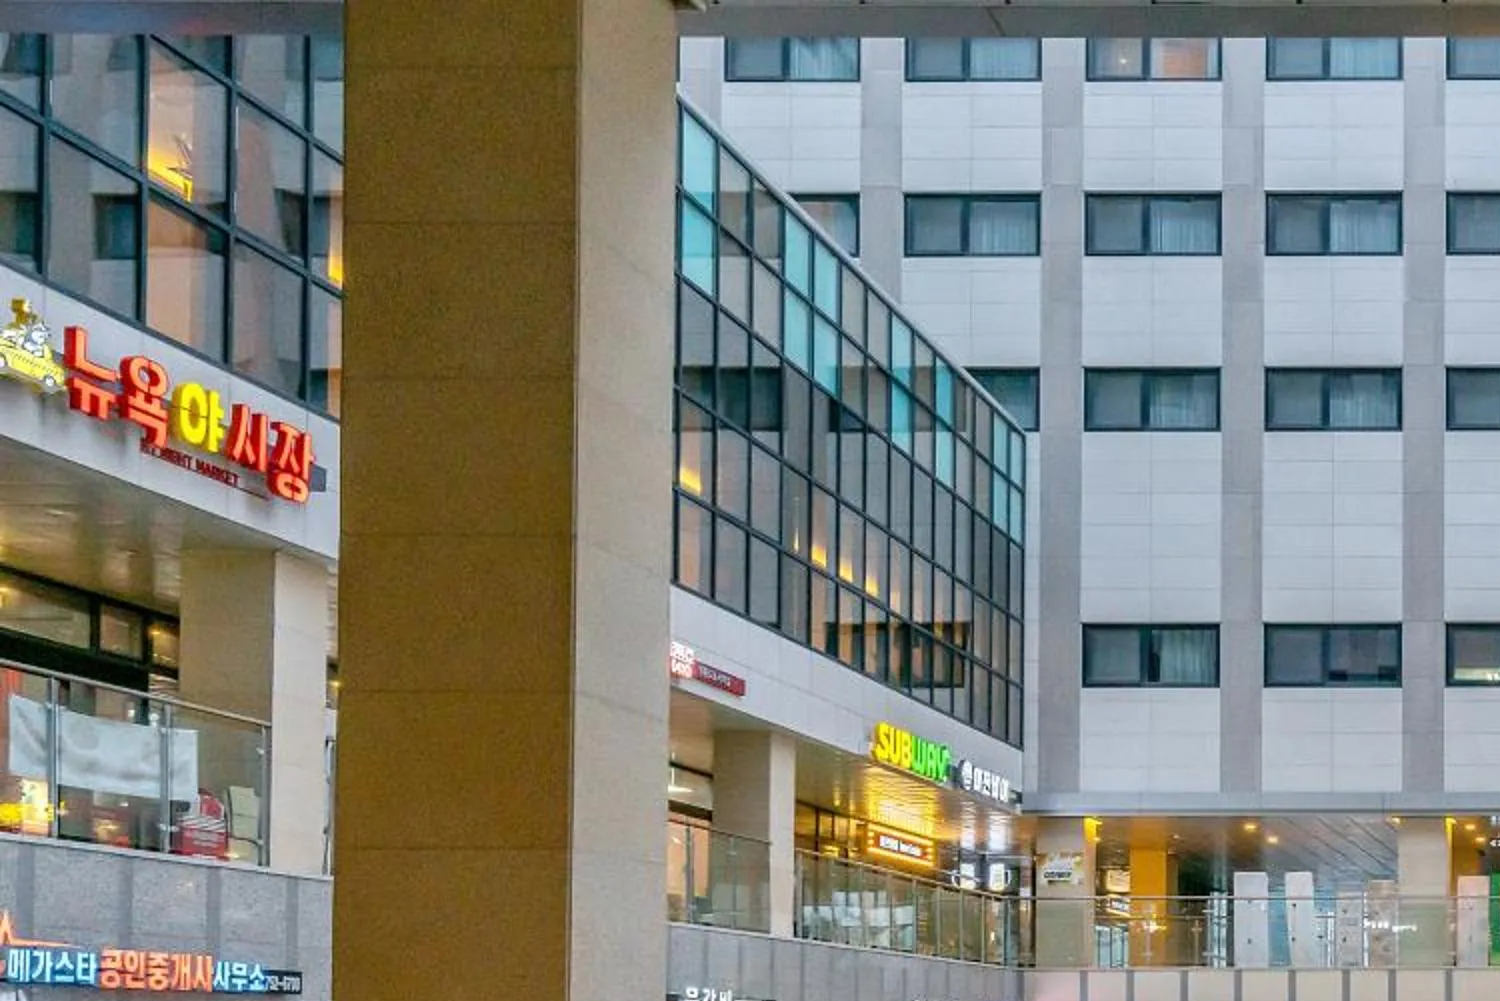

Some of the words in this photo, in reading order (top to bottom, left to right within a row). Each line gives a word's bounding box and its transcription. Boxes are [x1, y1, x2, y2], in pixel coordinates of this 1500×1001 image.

[64, 325, 317, 504] 뉴욕야시장
[195, 459, 239, 488] MARKET
[872, 721, 952, 783] SUBWAY
[7, 948, 97, 984] 메가스타
[100, 948, 213, 993] 공인중개사
[213, 960, 266, 992] 사무소
